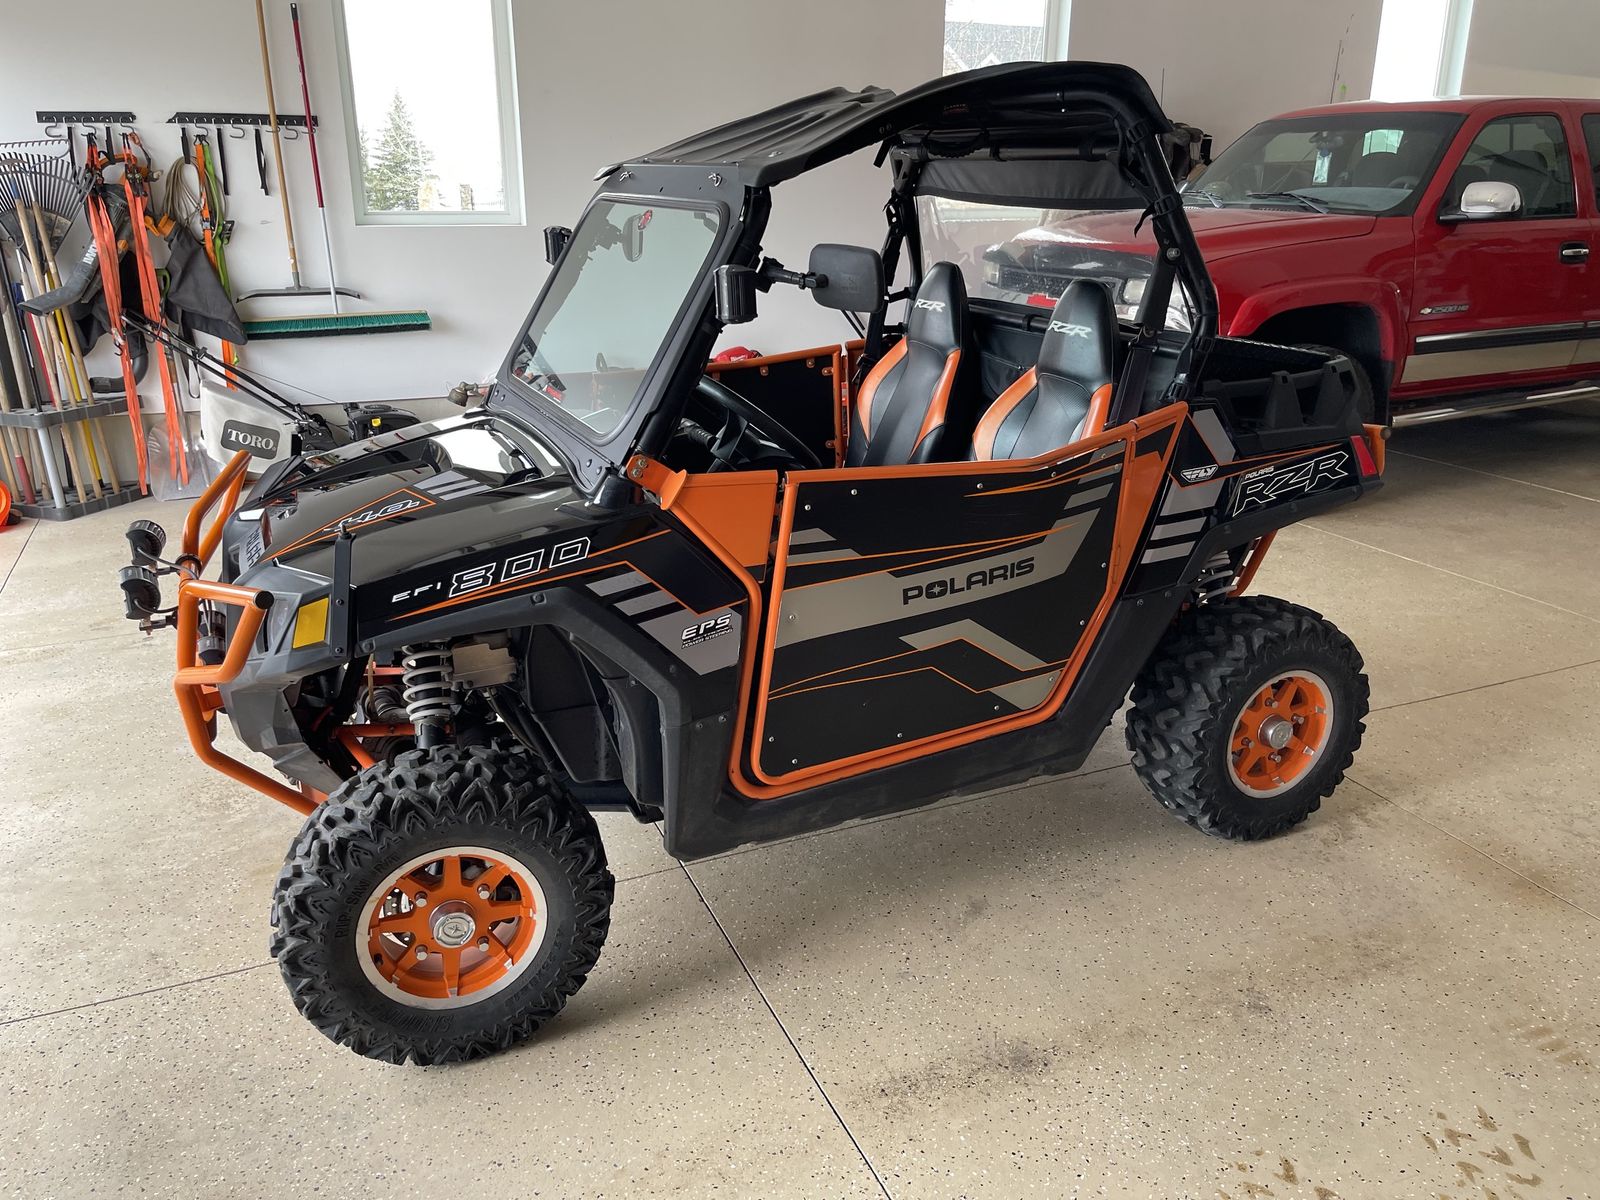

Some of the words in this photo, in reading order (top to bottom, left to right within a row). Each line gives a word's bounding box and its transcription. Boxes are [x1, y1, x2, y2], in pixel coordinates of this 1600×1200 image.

[915, 298, 946, 313] RZR
[1048, 320, 1093, 339] RZR
[228, 429, 274, 450] TORO
[1232, 451, 1349, 517] RZR
[1245, 466, 1275, 480] POLARIS
[391, 581, 442, 603] EFI
[448, 536, 591, 598] 800
[902, 556, 1035, 605] POLARIS
[681, 613, 732, 640] EPS
